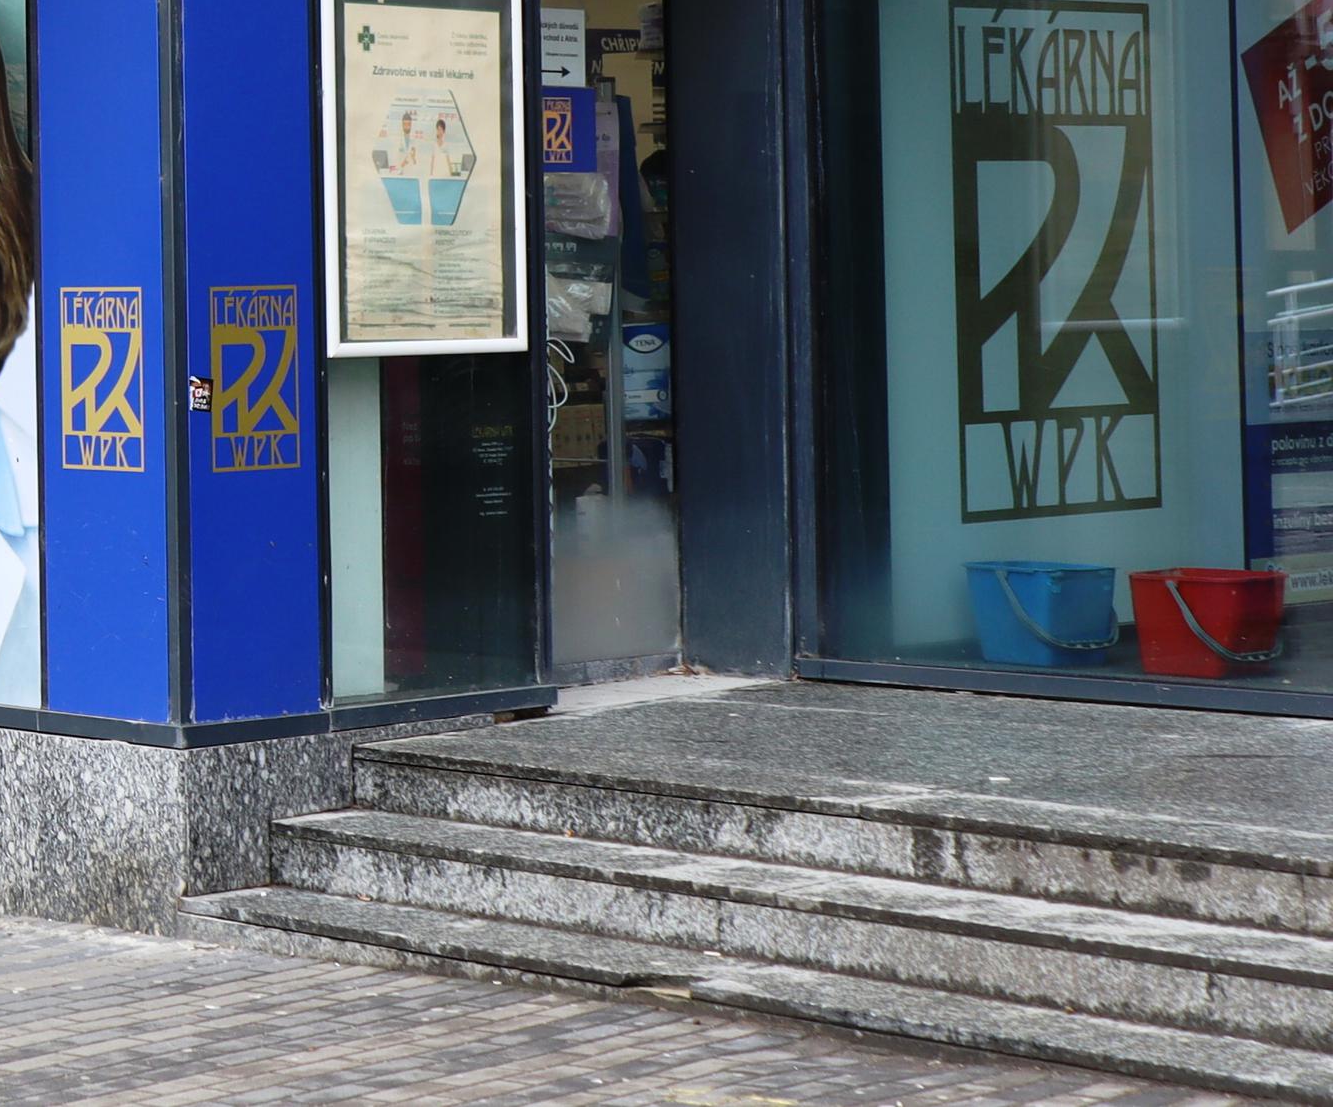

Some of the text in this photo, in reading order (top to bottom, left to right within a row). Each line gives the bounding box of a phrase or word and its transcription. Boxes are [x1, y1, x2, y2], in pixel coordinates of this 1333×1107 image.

[419, 69, 428, 78] ve
[956, 7, 1146, 116] LÉKÁRNA
[1278, 62, 1302, 109] AŽ
[63, 290, 139, 329] LÉKÁRNA
[213, 290, 294, 329] LÉKÁRNA
[78, 435, 129, 467] WPK
[229, 435, 286, 469] WPK
[1001, 414, 1126, 509] WPK
[1271, 433, 1317, 455] polovinu
